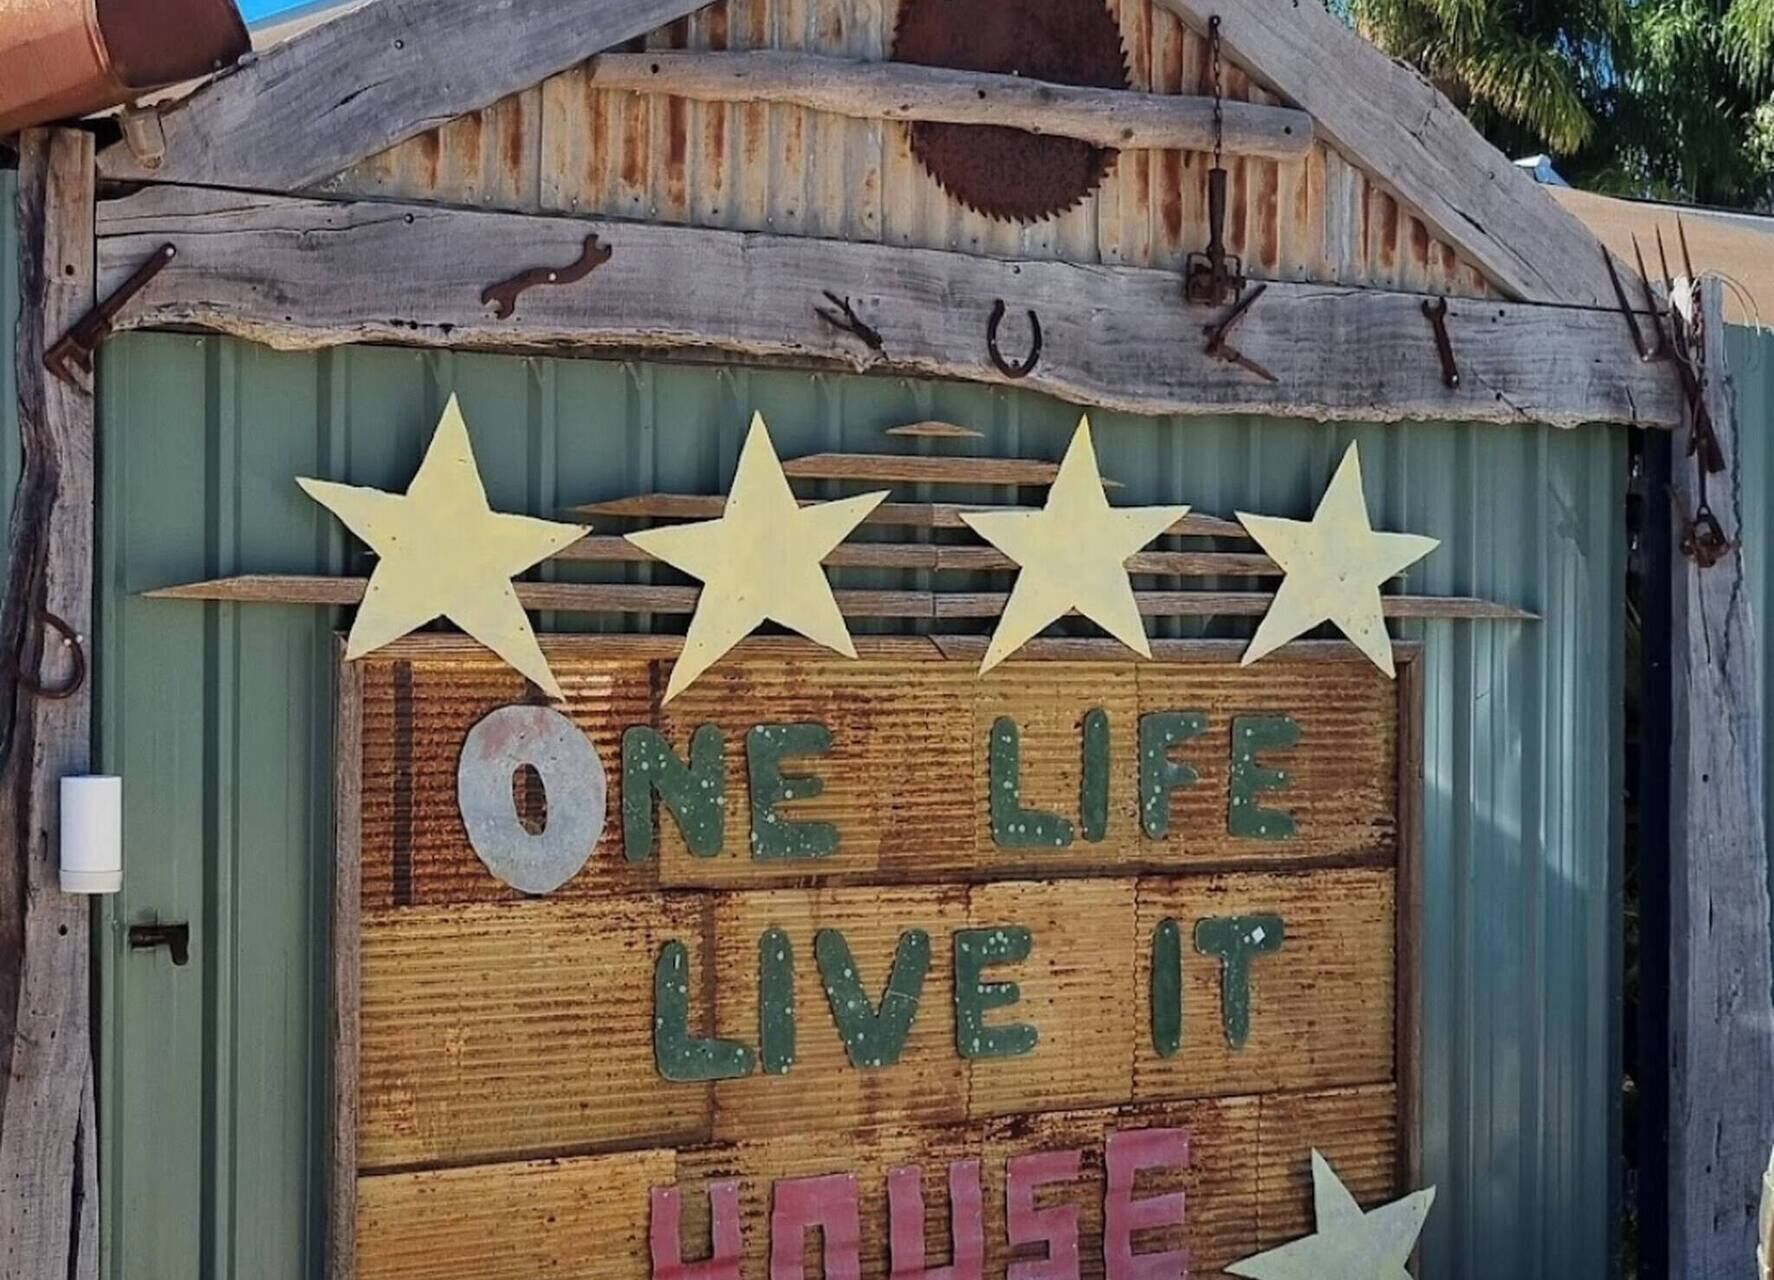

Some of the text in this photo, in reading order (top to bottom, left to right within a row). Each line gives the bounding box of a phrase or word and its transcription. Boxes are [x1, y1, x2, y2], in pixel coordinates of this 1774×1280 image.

[457, 703, 1303, 894] ONE LIFE
[652, 914, 1285, 1083] LIVE IT
